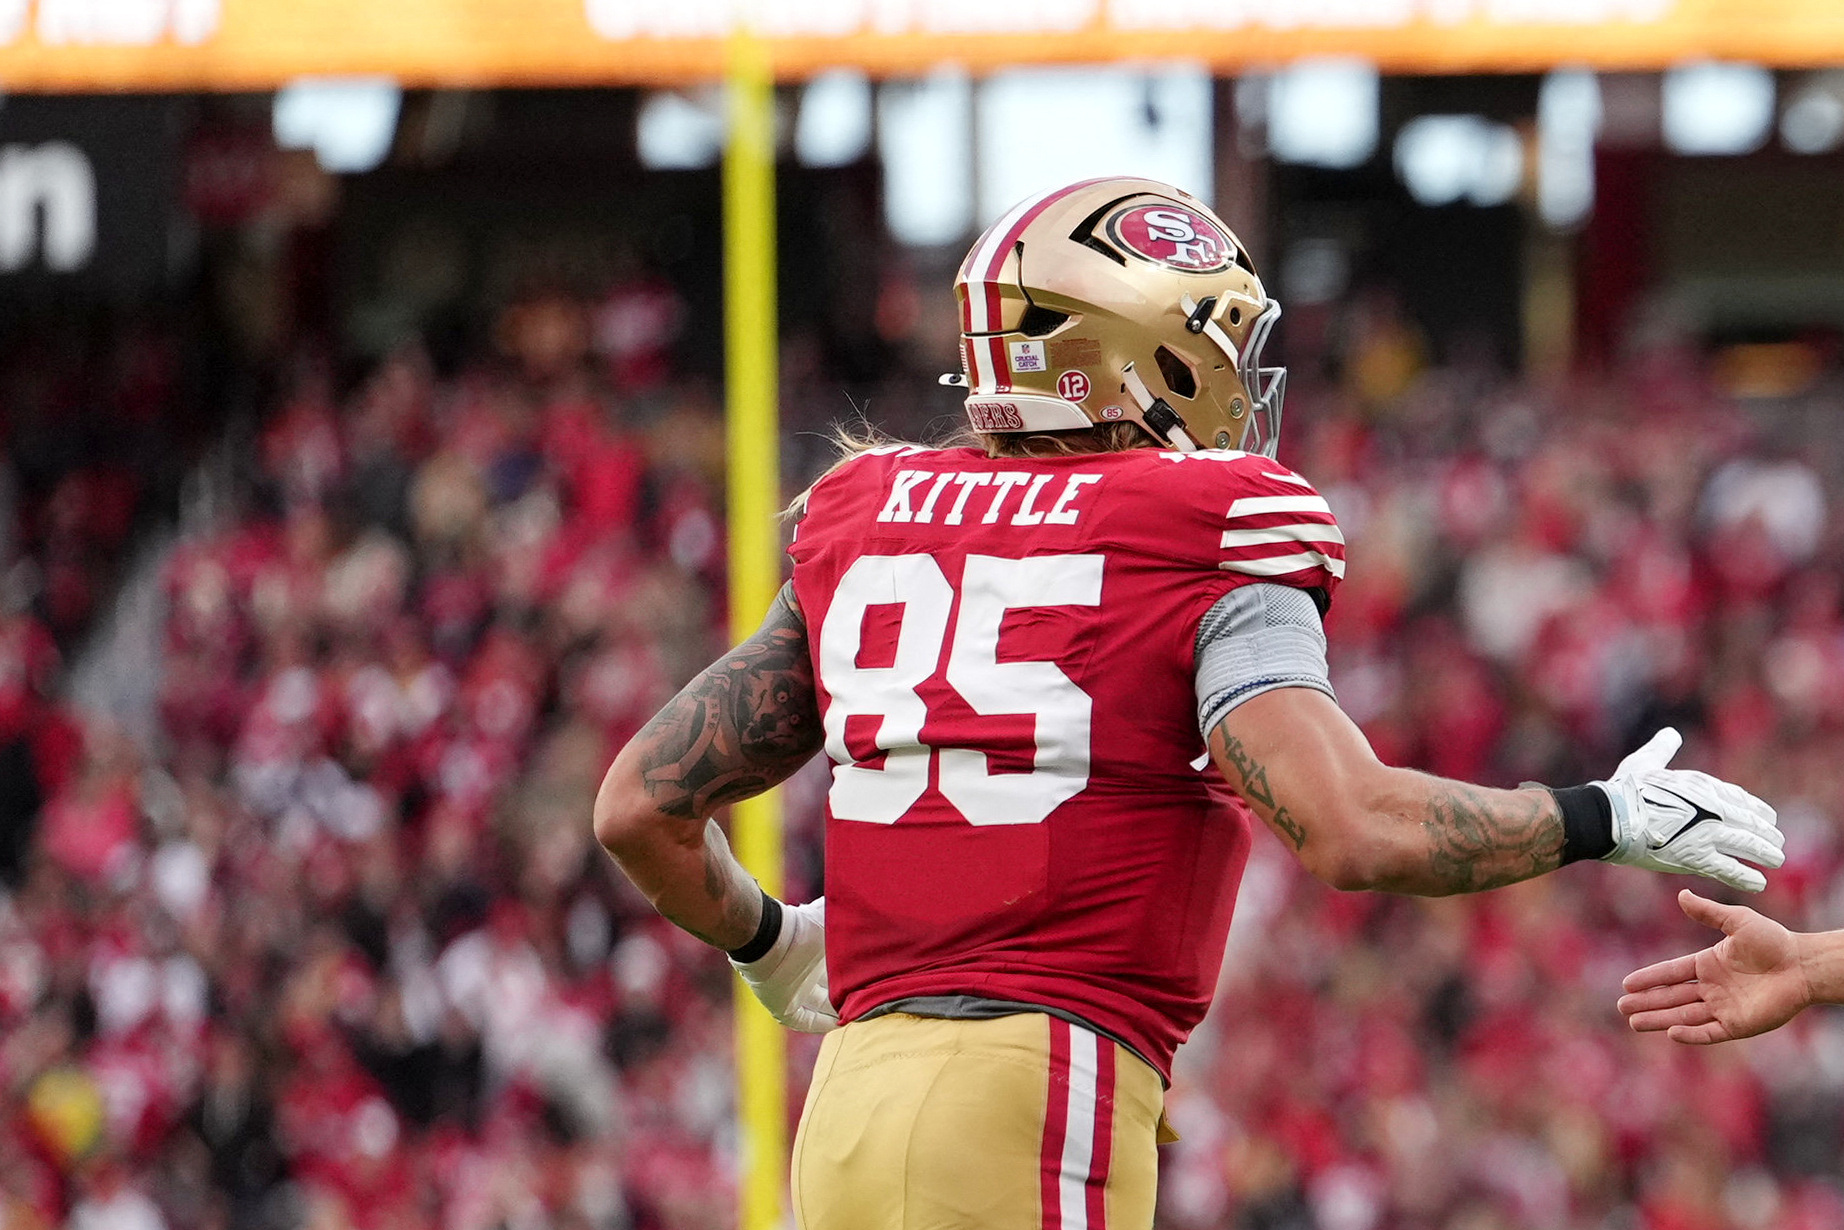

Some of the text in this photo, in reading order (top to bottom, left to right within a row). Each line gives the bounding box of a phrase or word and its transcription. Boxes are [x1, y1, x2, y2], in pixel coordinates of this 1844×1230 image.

[1062, 375, 1085, 398] 12
[1107, 408, 1119, 418] 85
[876, 470, 1104, 527] KITTLE
[819, 554, 1106, 827] 85
